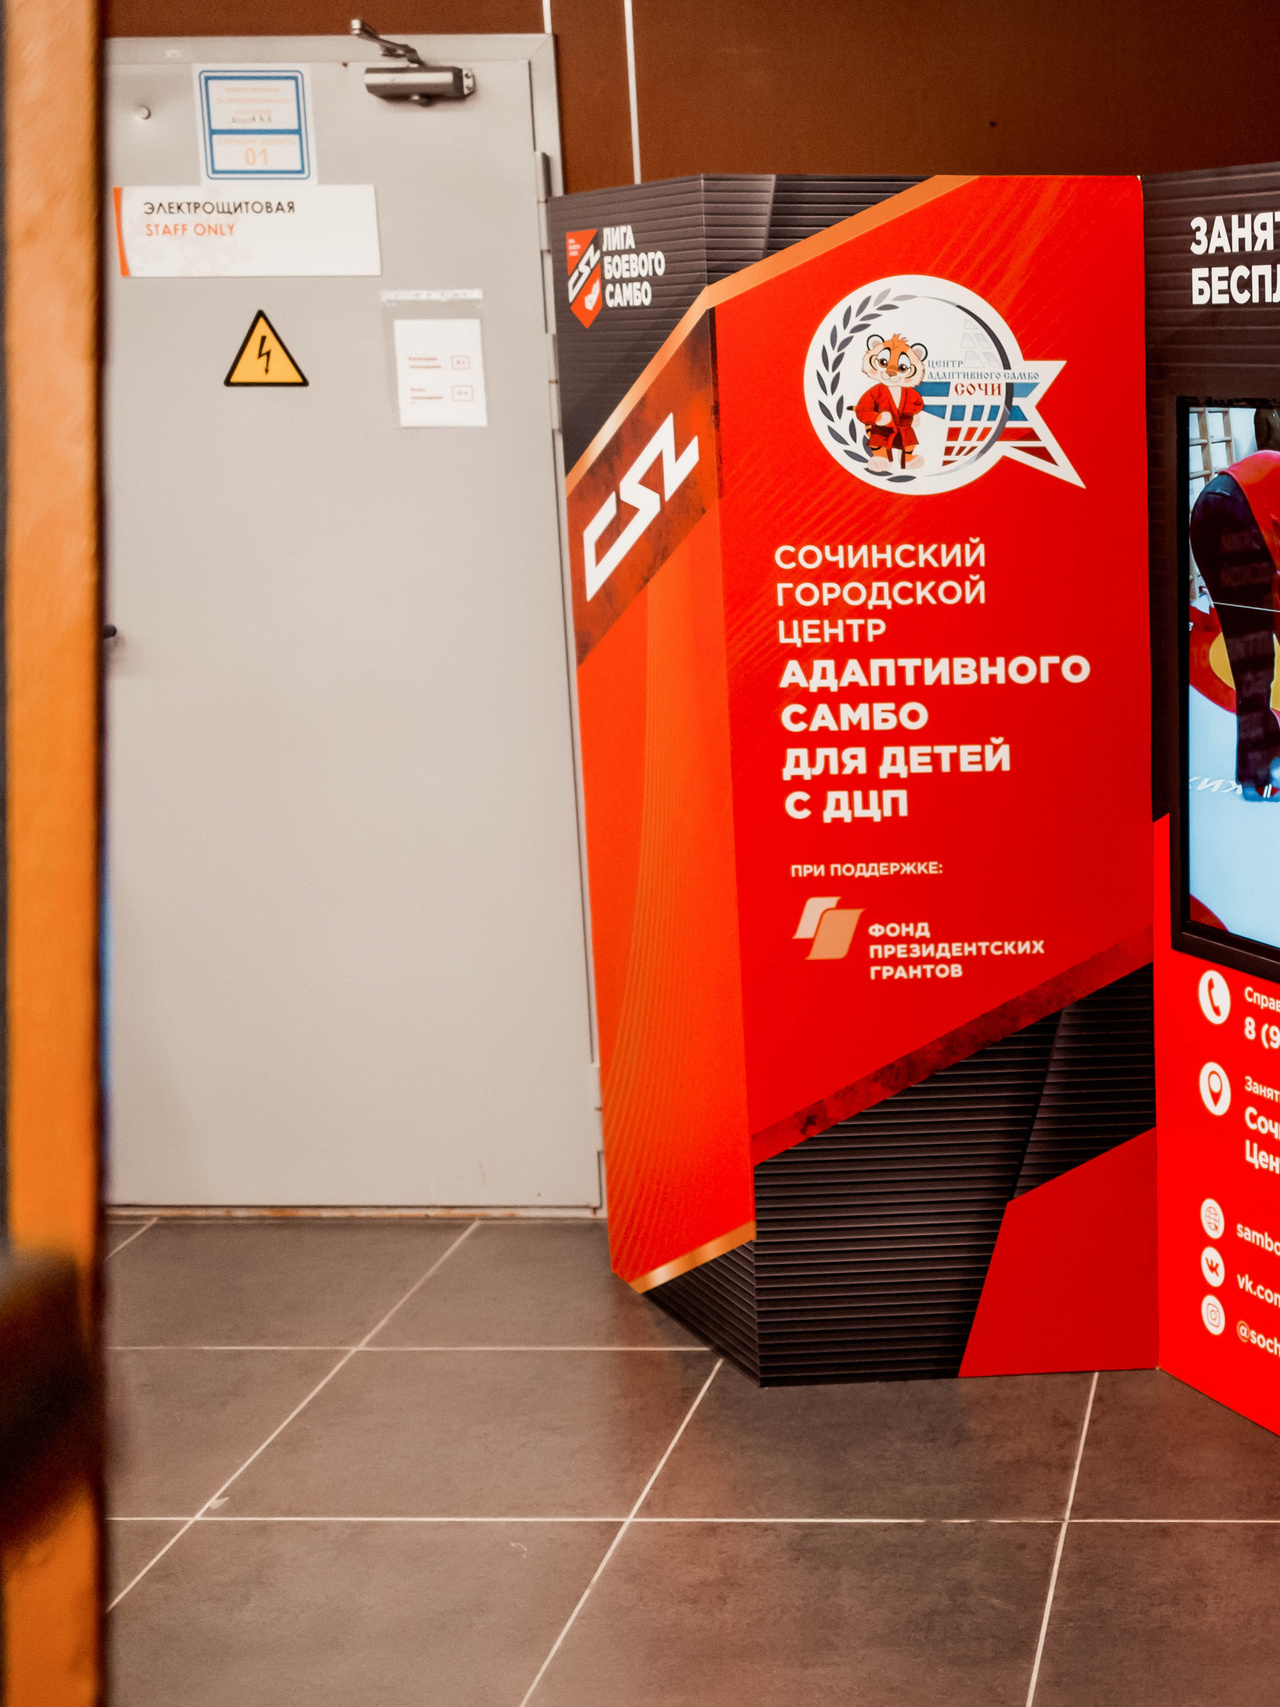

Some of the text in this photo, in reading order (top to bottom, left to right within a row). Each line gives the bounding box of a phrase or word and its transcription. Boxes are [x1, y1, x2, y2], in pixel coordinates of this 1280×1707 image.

[143, 200, 295, 216] ЭЛЕКТРОЩИТОВАЯ
[145, 222, 235, 236] STAFF ONLY
[602, 225, 635, 252] ЛИГА
[603, 251, 666, 280] БОЕВОГО
[605, 281, 652, 308] САМБО
[927, 371, 1040, 380] АДАПТИВНОГО САМБО
[928, 360, 964, 369] ЦЕНТР
[954, 382, 1002, 396] СОЧИ
[774, 536, 985, 570] СОЧИНСКИЙ
[776, 573, 985, 610] ГОРОДСКОЙ
[778, 618, 887, 648] ЦЕНТР
[779, 655, 1091, 692] АДАПТИВНОГО
[781, 701, 929, 732] САМБО
[782, 736, 1011, 781] ДЛЯ ДЕТЕЙ
[784, 789, 908, 823] С ДЦП
[791, 861, 943, 878] ПРИ ПОДДЕРЖКЕ:
[868, 922, 931, 938] ФОНД
[869, 940, 1045, 959] ПРЕЗИДЕНТСКИХ
[870, 964, 963, 980] ГРАНТОВ
[1243, 1016, 1257, 1040] 8
